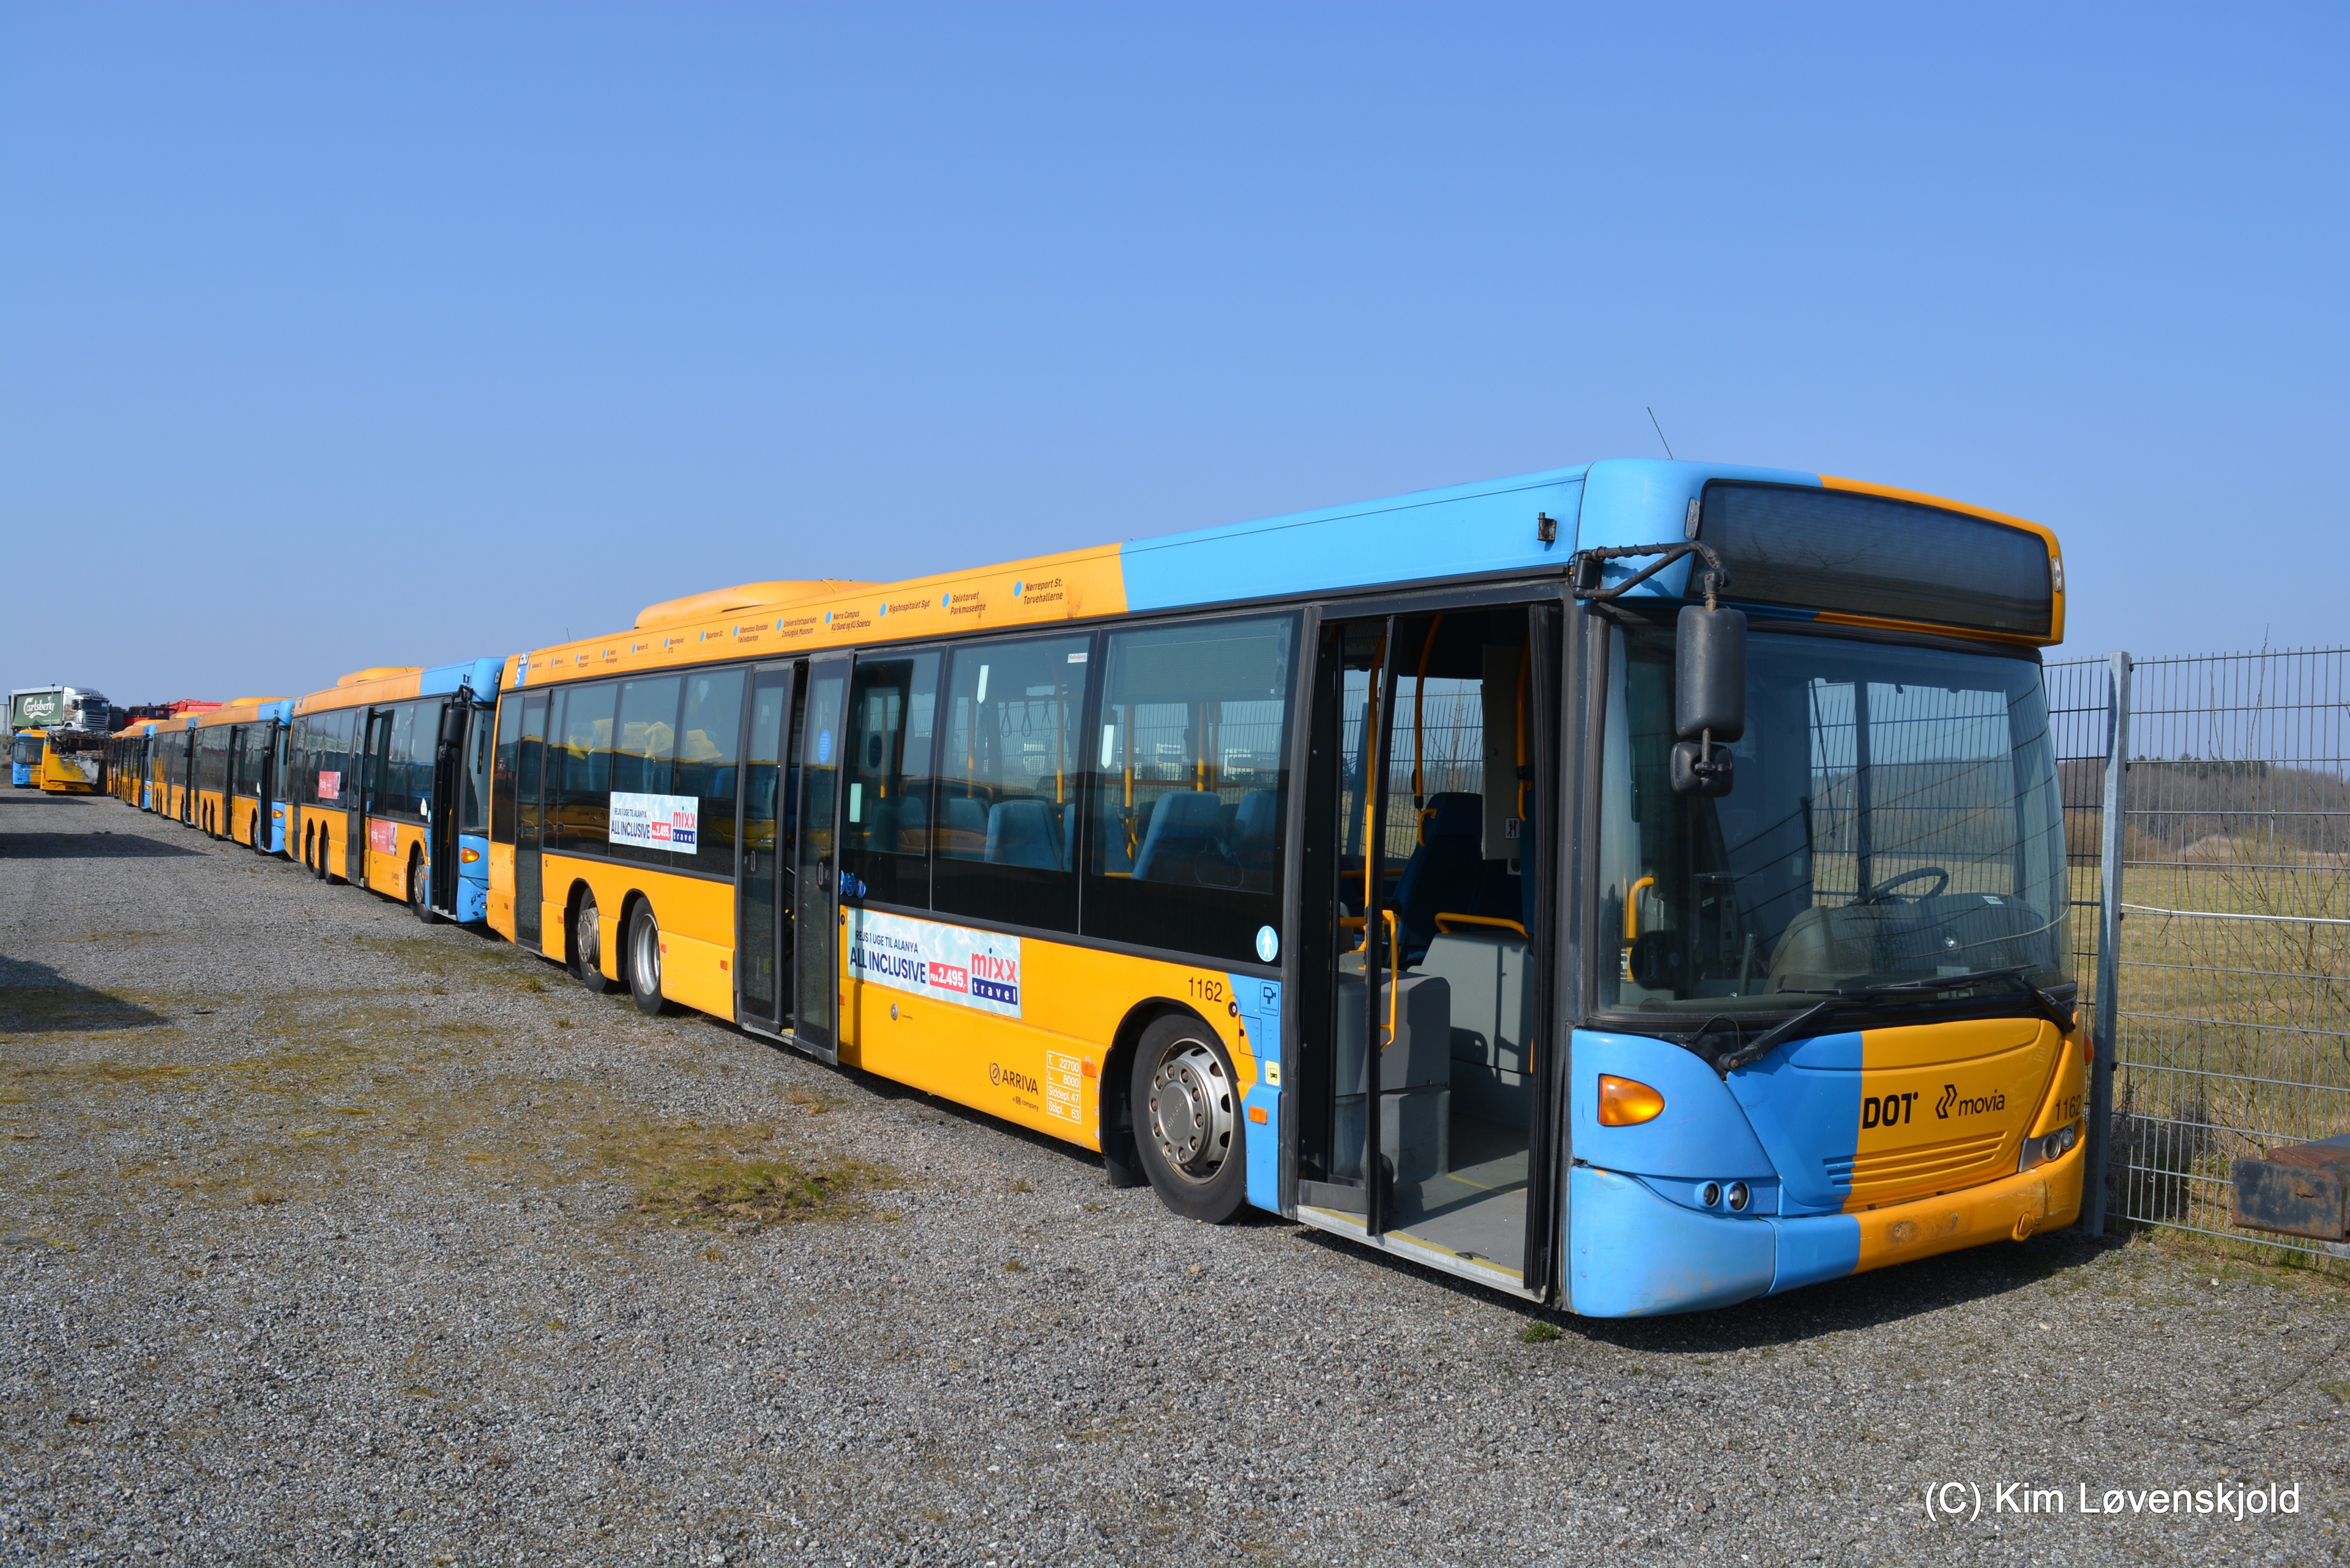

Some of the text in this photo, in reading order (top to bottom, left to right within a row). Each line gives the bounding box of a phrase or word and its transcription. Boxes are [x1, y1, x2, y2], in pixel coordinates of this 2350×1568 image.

[1025, 578, 1062, 592] Nørreport St.
[889, 599, 930, 614] Rigshospitalet Syd
[952, 592, 979, 603] Sølvtorvet
[1024, 592, 1063, 605] Torvehallerne
[844, 611, 860, 619] Campus
[950, 603, 986, 615] Parkmuseerne
[783, 617, 817, 627] Universitetsparken
[23, 696, 55, 717] Carlsberg
[634, 810, 647, 819] ALANYA
[673, 806, 696, 829] mixx
[611, 820, 650, 839] ALL INCLUSIVE
[673, 831, 695, 842] travel
[856, 930, 868, 943] REJS
[869, 932, 872, 943] 1
[873, 933, 884, 946] UGE
[893, 938, 919, 954] ALANYA
[850, 946, 926, 984] ALL INCLUSIVE
[971, 947, 1017, 984] mixx
[930, 966, 967, 990] FRA 2.495,-
[974, 981, 1016, 1002] travel
[1188, 976, 1222, 1003] 1162
[1048, 1055, 1079, 1073] T. 22700
[1002, 1069, 1039, 1096] ARRIVA
[1048, 1070, 1079, 1088] L 8000
[1048, 1086, 1079, 1103] Siddepl. 47
[1958, 1089, 2005, 1116] movia
[1021, 1100, 1039, 1112] company
[1048, 1101, 1079, 1119] Ståpl. 63
[1862, 1091, 1919, 1129] DOT
[2056, 1094, 2081, 1121] 1162
